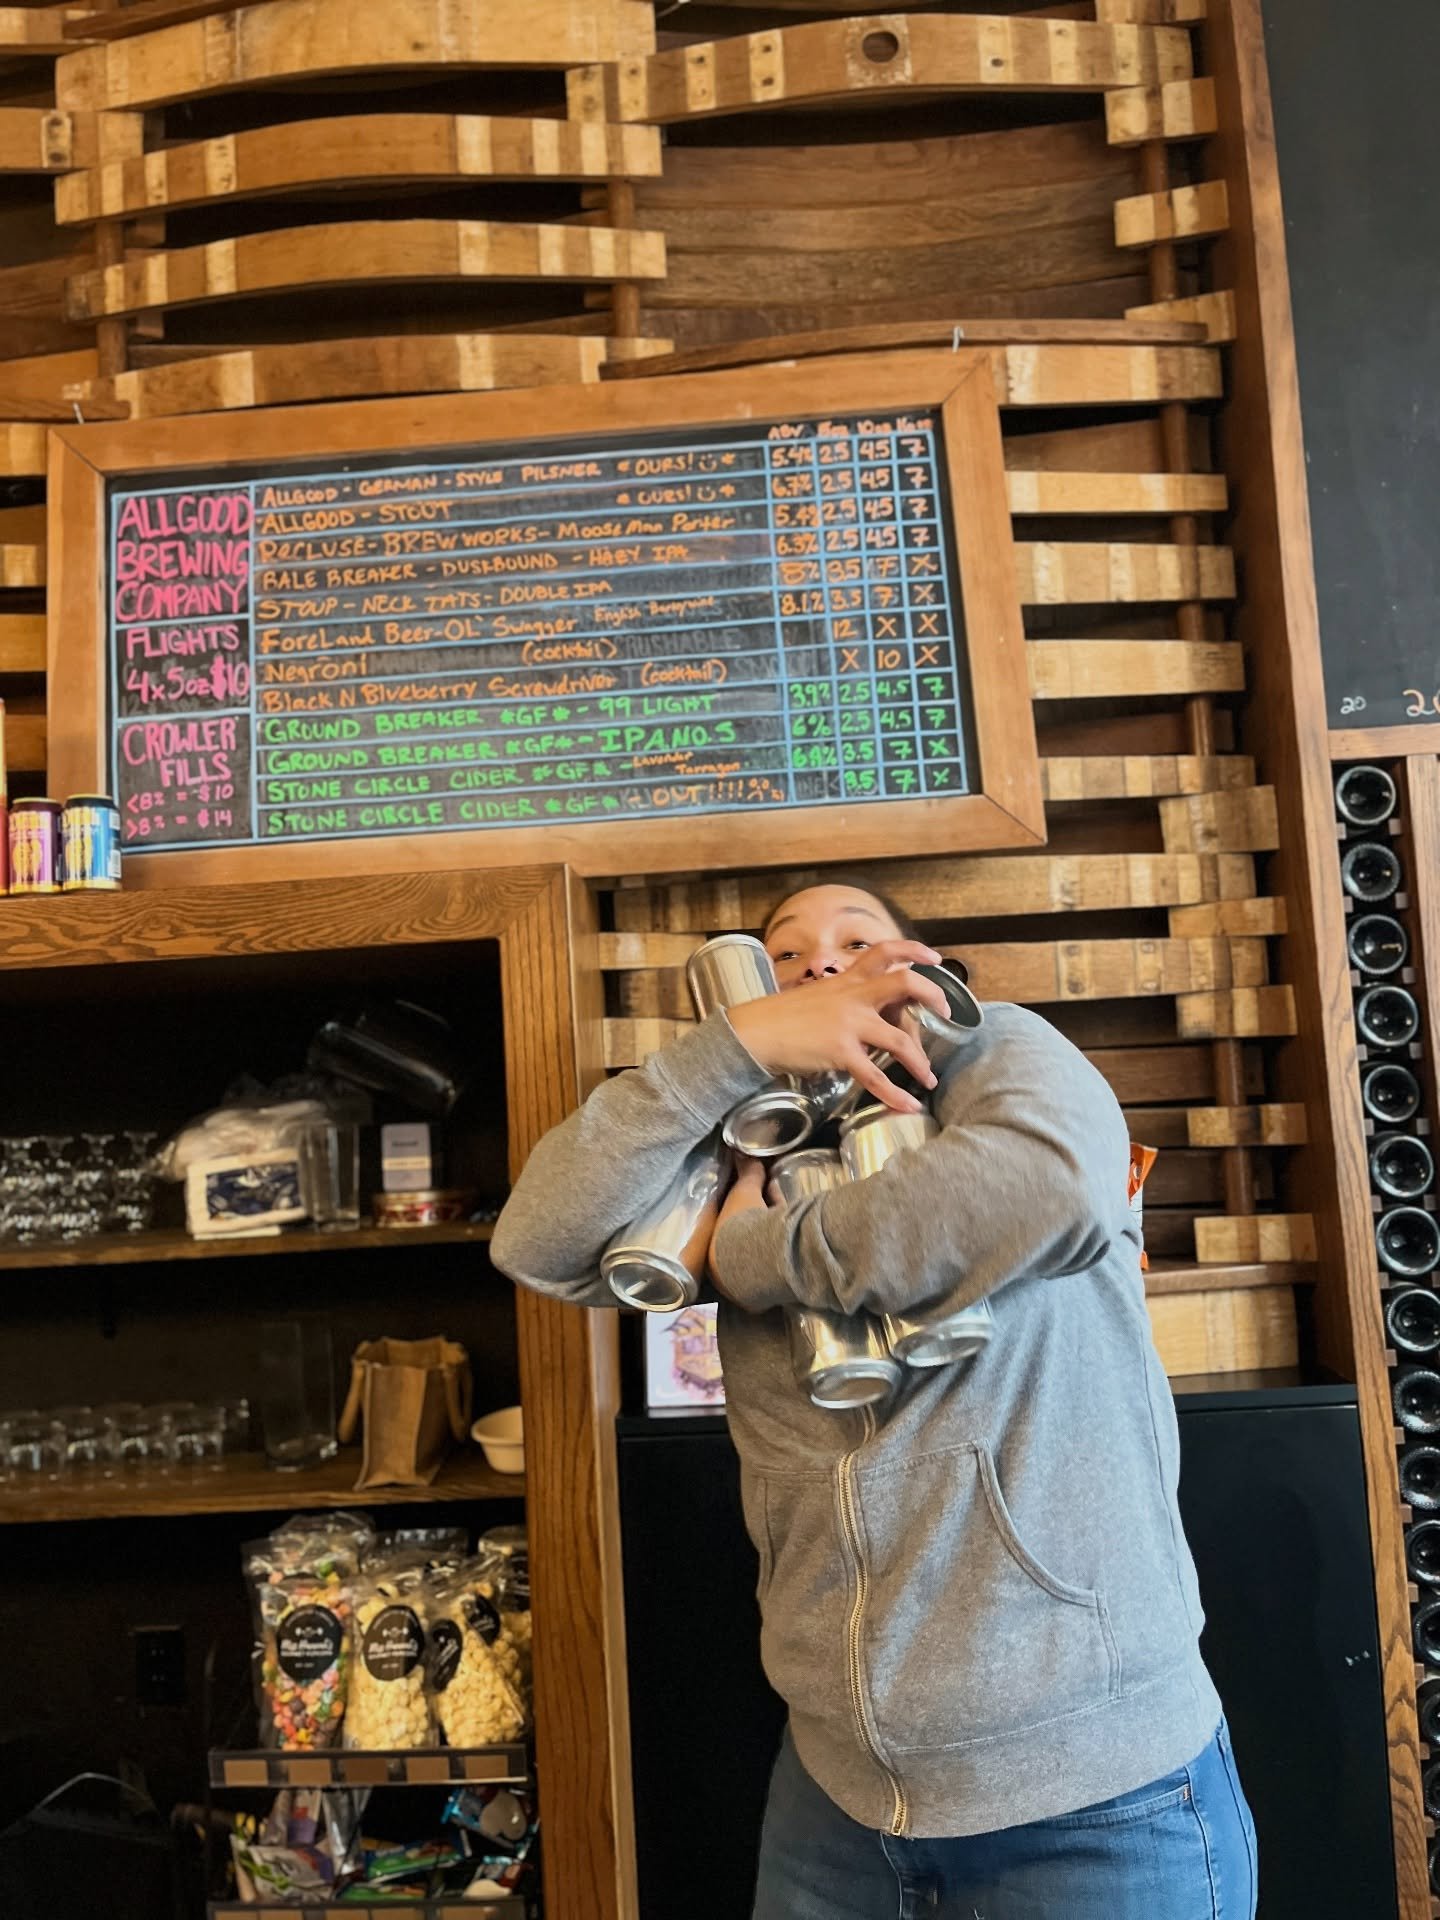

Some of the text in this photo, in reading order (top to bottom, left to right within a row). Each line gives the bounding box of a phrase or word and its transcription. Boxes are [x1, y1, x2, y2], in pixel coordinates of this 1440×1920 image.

[768, 423, 804, 440] ABV
[261, 510, 355, 534] ALLGOOD
[379, 500, 452, 524] STOUT
[772, 473, 813, 497] 6.7%
[821, 471, 852, 493] 2.5
[861, 468, 890, 489] 4.5
[904, 466, 928, 489] 7
[262, 487, 338, 508] ALLGOOD
[359, 474, 437, 496] GERMAN
[455, 470, 503, 487] STYLE
[521, 463, 601, 482] PILSNER
[819, 442, 850, 464] 2.5
[860, 439, 891, 460] 4.5
[900, 438, 925, 456] 7
[118, 494, 254, 538] ALLGOOD
[672, 512, 736, 532] Porter
[823, 498, 856, 521] 2.5
[908, 498, 928, 518] 7
[117, 540, 250, 580] BREWING
[257, 597, 338, 619] STOUP
[362, 594, 416, 614] NECK
[500, 584, 570, 604] DOUBLE
[572, 580, 613, 597] IPA
[876, 556, 898, 577] 7
[263, 569, 317, 591] BALE
[327, 563, 417, 588] BREAKER
[442, 553, 558, 577] DUSKBOUND
[652, 544, 688, 562] IPA
[776, 534, 818, 555] 6.3%
[826, 528, 859, 551] 2.5
[866, 526, 896, 548] 4.5
[911, 527, 930, 546] 7
[116, 579, 247, 622] COMPANY
[493, 616, 577, 641] Swagger
[781, 592, 824, 615] 8.1%
[873, 586, 893, 608] 7
[127, 624, 240, 659] FLIGHTS
[265, 653, 367, 685] Negroni
[834, 619, 858, 639] 12
[262, 690, 333, 712] Black
[340, 688, 356, 707] N
[361, 681, 477, 706] Blueberry
[488, 674, 617, 698] Screwdriver
[878, 649, 900, 669] 10
[265, 718, 360, 743] GROUND
[375, 709, 483, 735] BREAKER
[599, 696, 631, 719] 99
[643, 694, 716, 716] LIGHT
[839, 681, 870, 703] 2.5
[877, 679, 910, 697] 4.5
[922, 677, 945, 698] 7
[123, 718, 236, 765] CROWLER
[160, 752, 232, 787] FILLS
[268, 750, 368, 774] GROUND
[378, 741, 498, 766] BREAKER
[791, 714, 832, 738] 6%
[841, 710, 871, 733] 2.5
[880, 709, 911, 729] 4.5
[925, 708, 946, 729] 7
[267, 780, 341, 802] STONE
[355, 775, 430, 795] CIRCLE
[450, 767, 524, 789] CIDER
[633, 751, 694, 768] Lavender
[842, 741, 874, 762] 3.5
[889, 740, 912, 760] 7
[675, 762, 741, 779] Tarragon
[268, 809, 347, 834] STONE
[360, 802, 443, 826] CIRCLE
[460, 798, 537, 820] CIDER
[890, 769, 916, 793] 7
